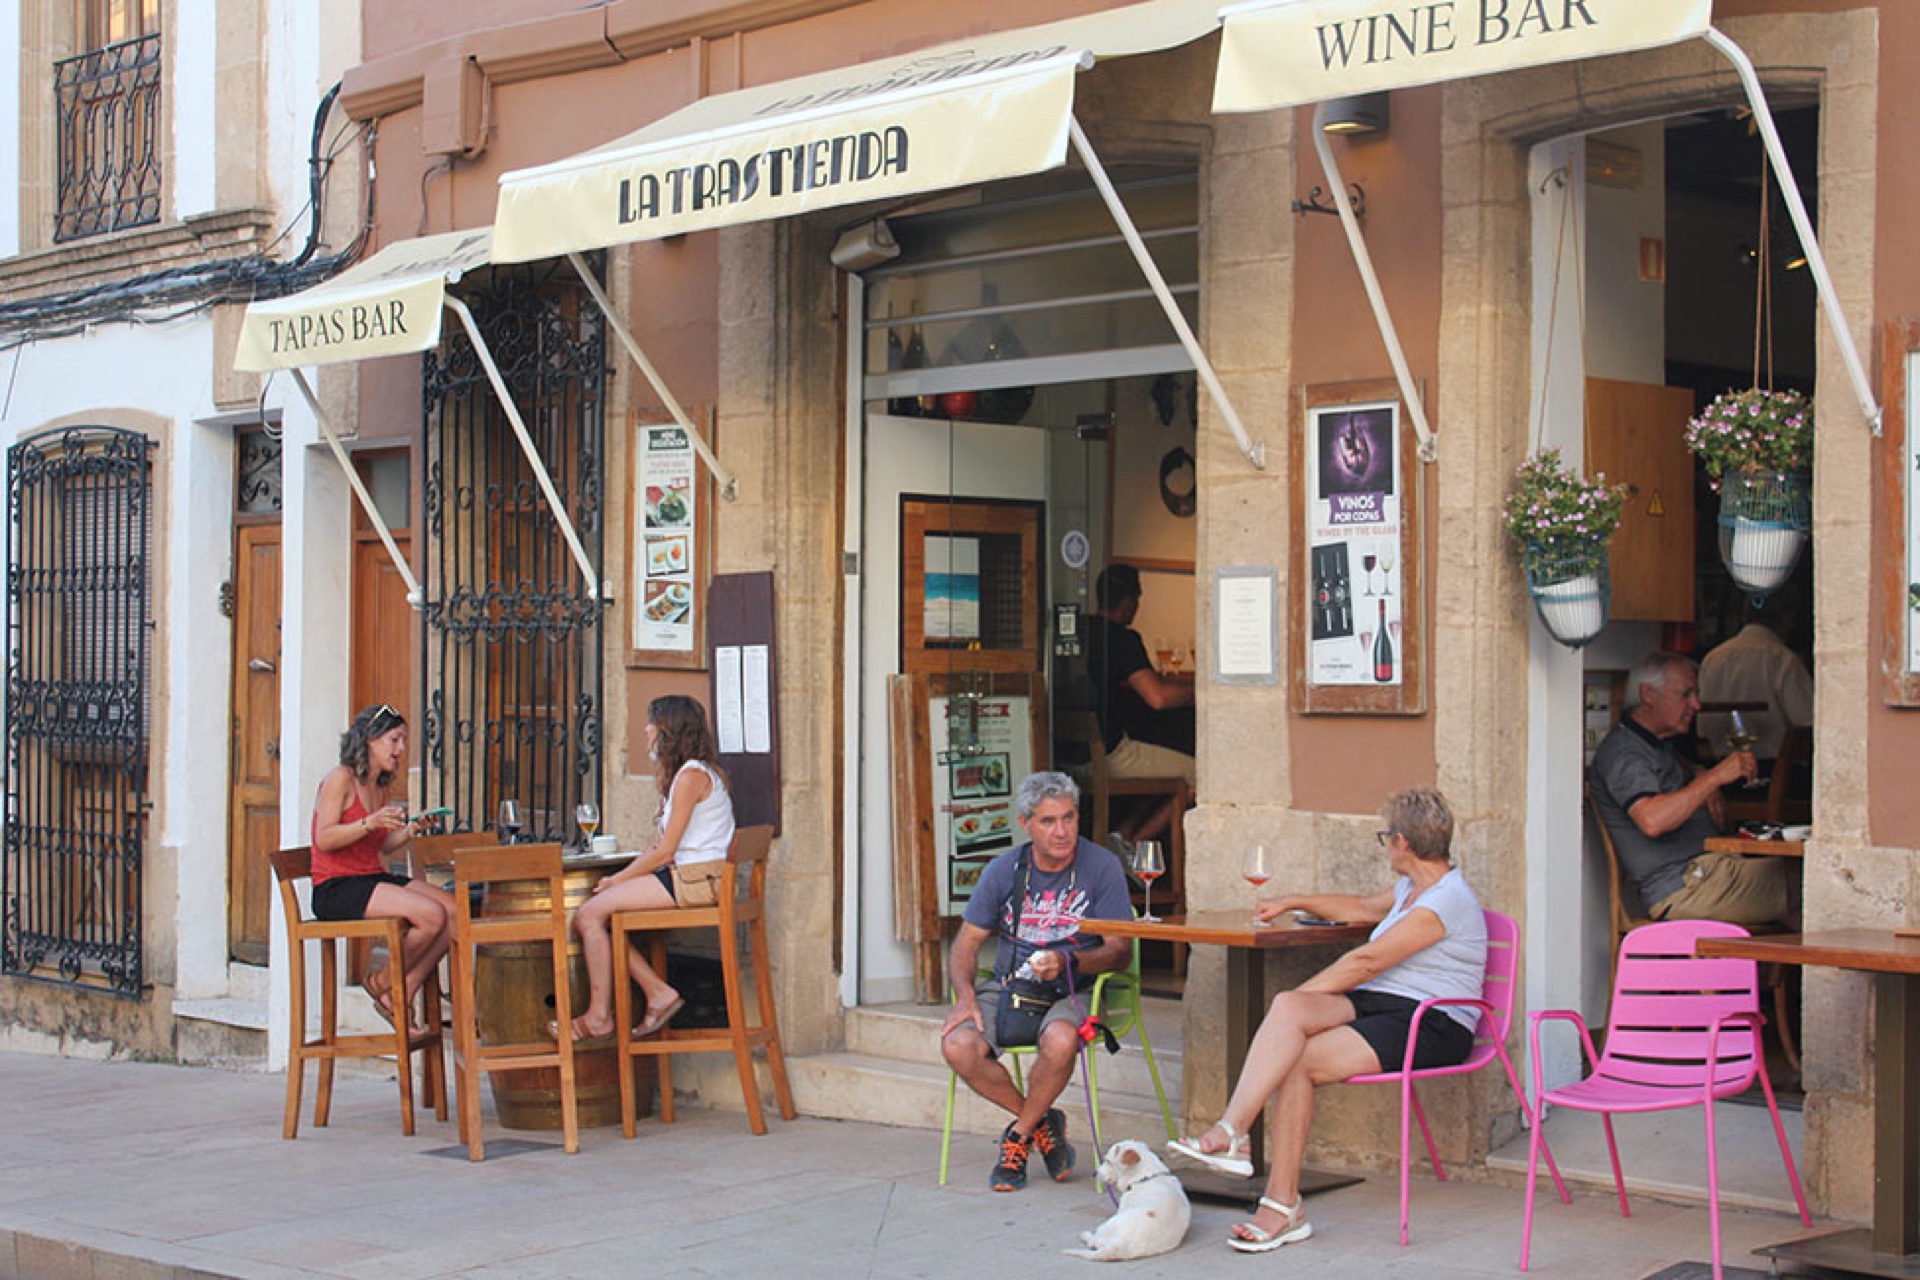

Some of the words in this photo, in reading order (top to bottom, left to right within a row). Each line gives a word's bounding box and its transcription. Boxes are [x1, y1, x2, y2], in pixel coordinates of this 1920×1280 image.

[1315, 2, 1456, 71] WINE
[1475, 0, 1598, 45] BAR
[618, 173, 661, 224] LA
[665, 125, 909, 215] TRASTIENDA
[269, 308, 346, 353] TAPAS
[352, 299, 408, 341] BAR
[1338, 494, 1375, 510] VINOS
